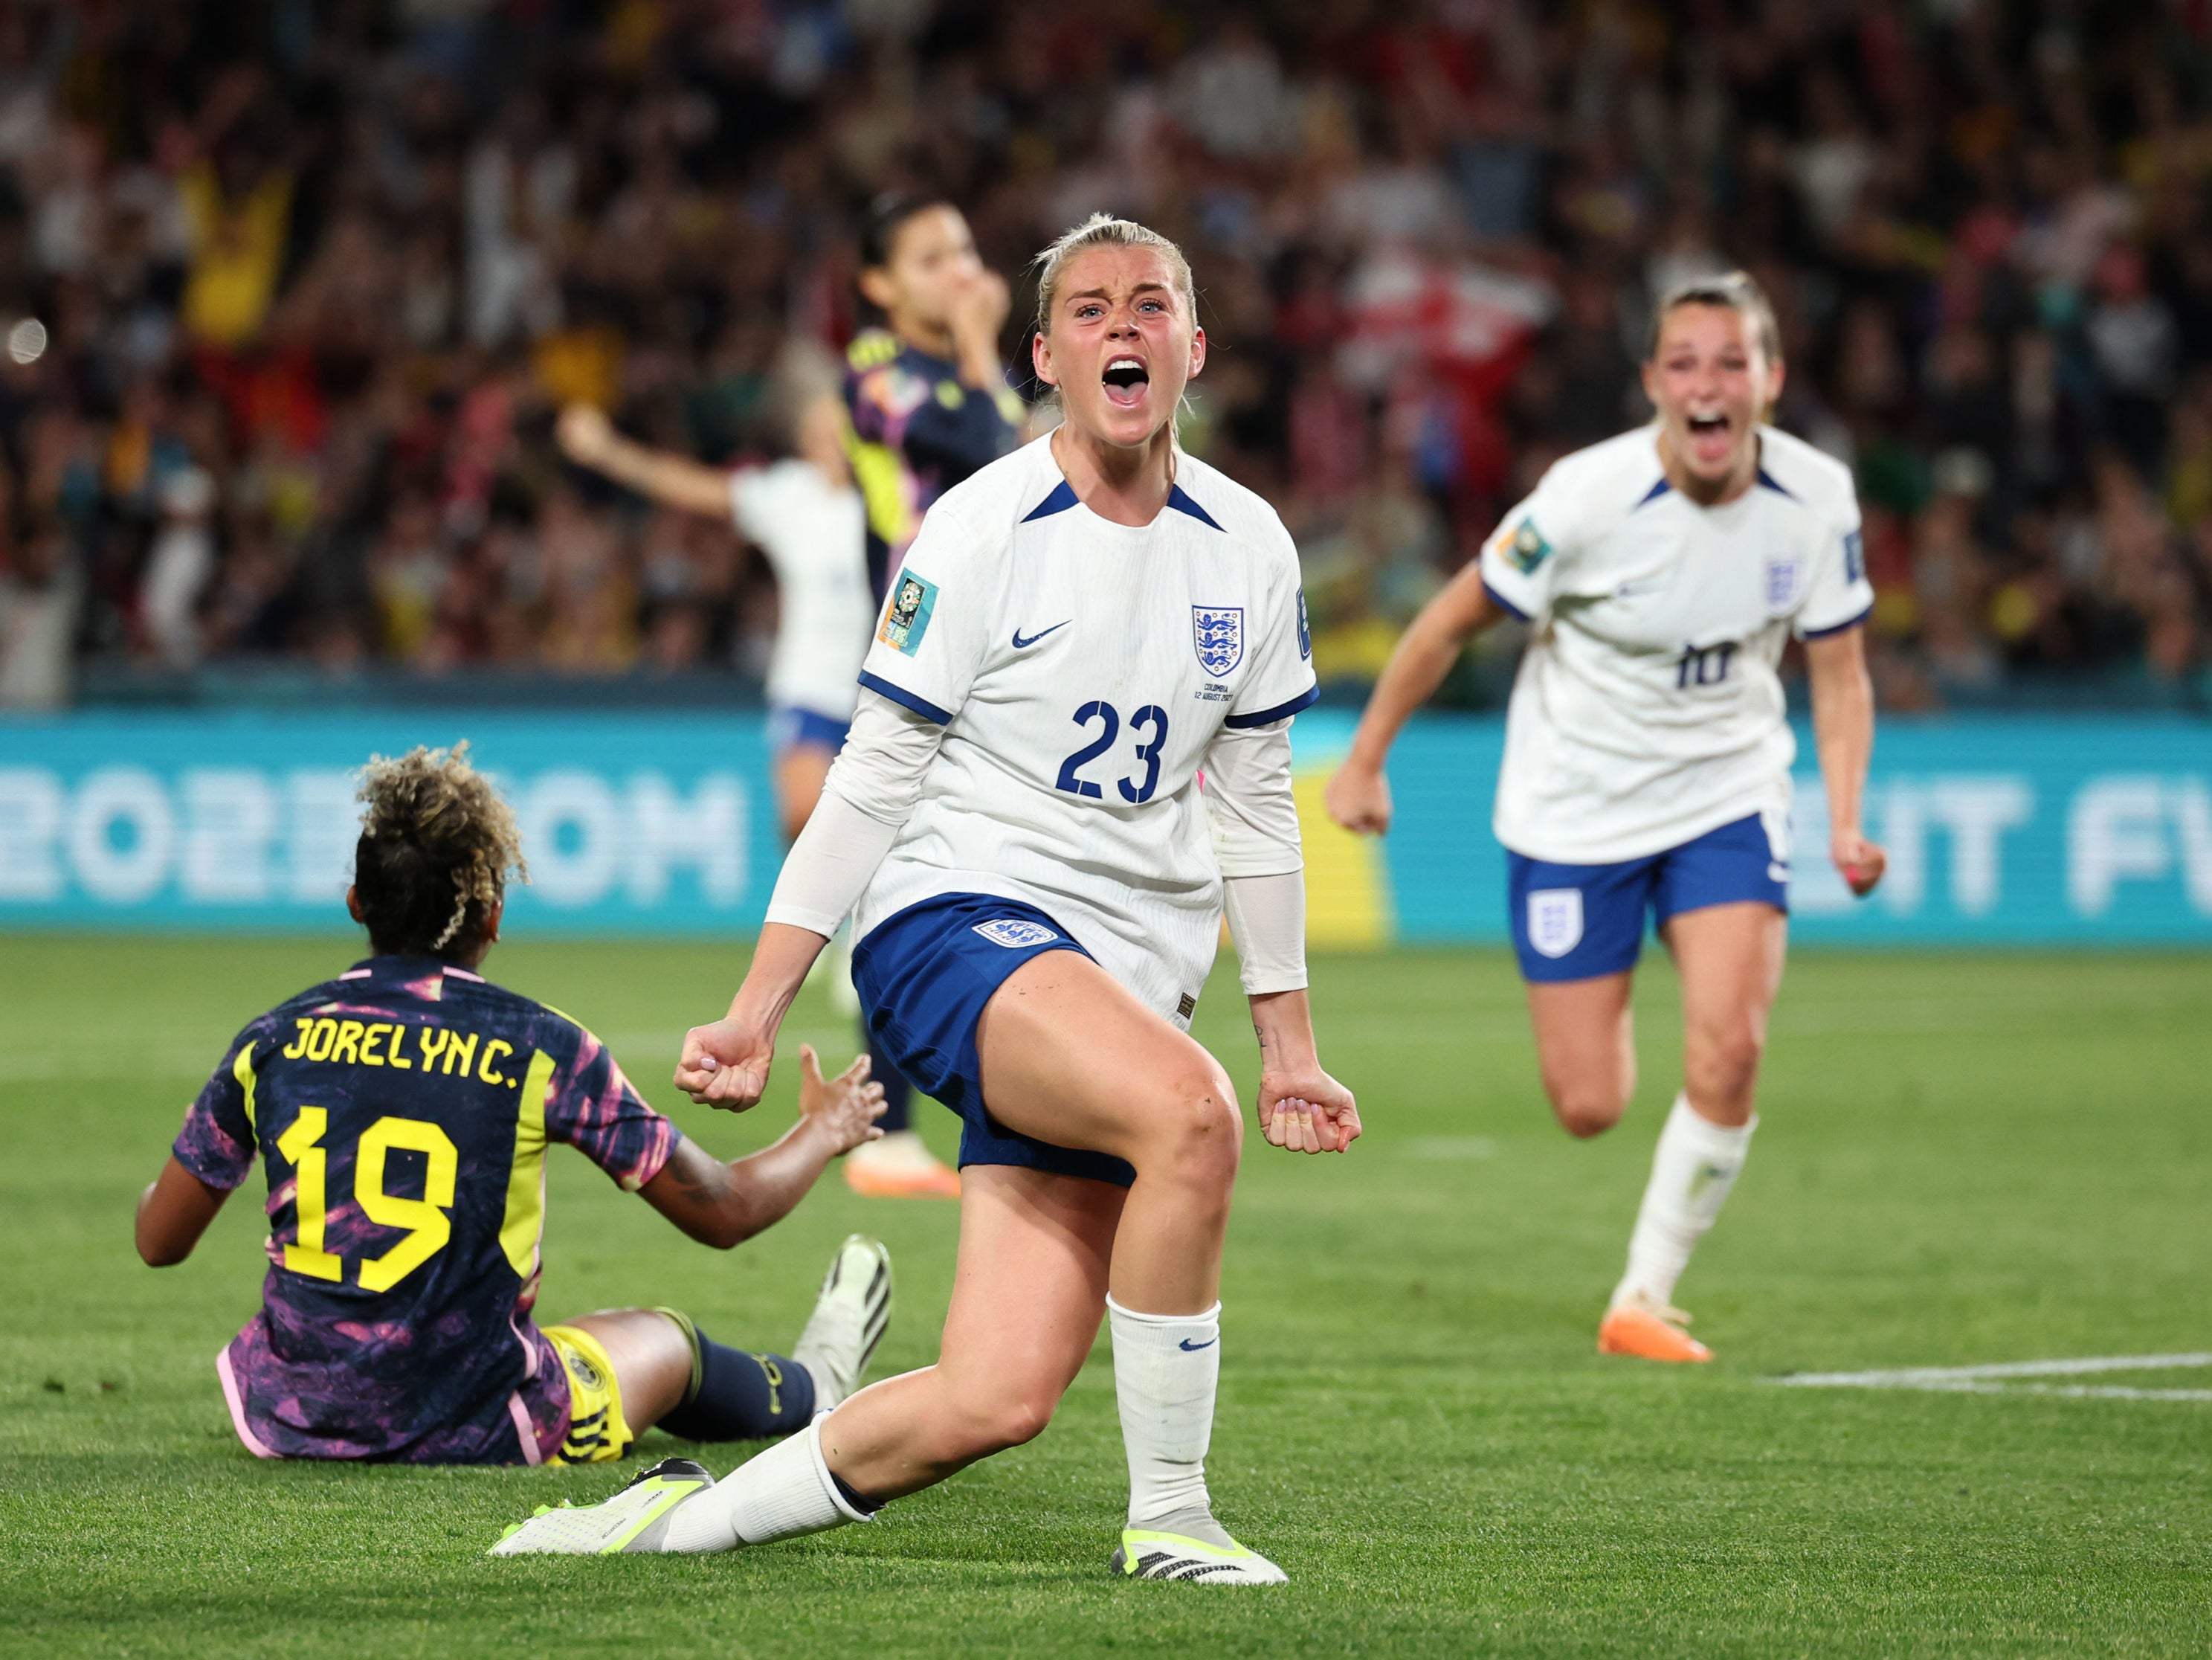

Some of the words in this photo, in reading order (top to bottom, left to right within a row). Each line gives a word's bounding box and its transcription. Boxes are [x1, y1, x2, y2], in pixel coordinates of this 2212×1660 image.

[1202, 692, 1220, 701] AUGUST
[1677, 641, 1738, 689] 10
[1055, 701, 1168, 804] 23
[283, 1017, 478, 1078] JORELYN
[477, 1037, 517, 1089] C.
[277, 1106, 458, 1293] 19
